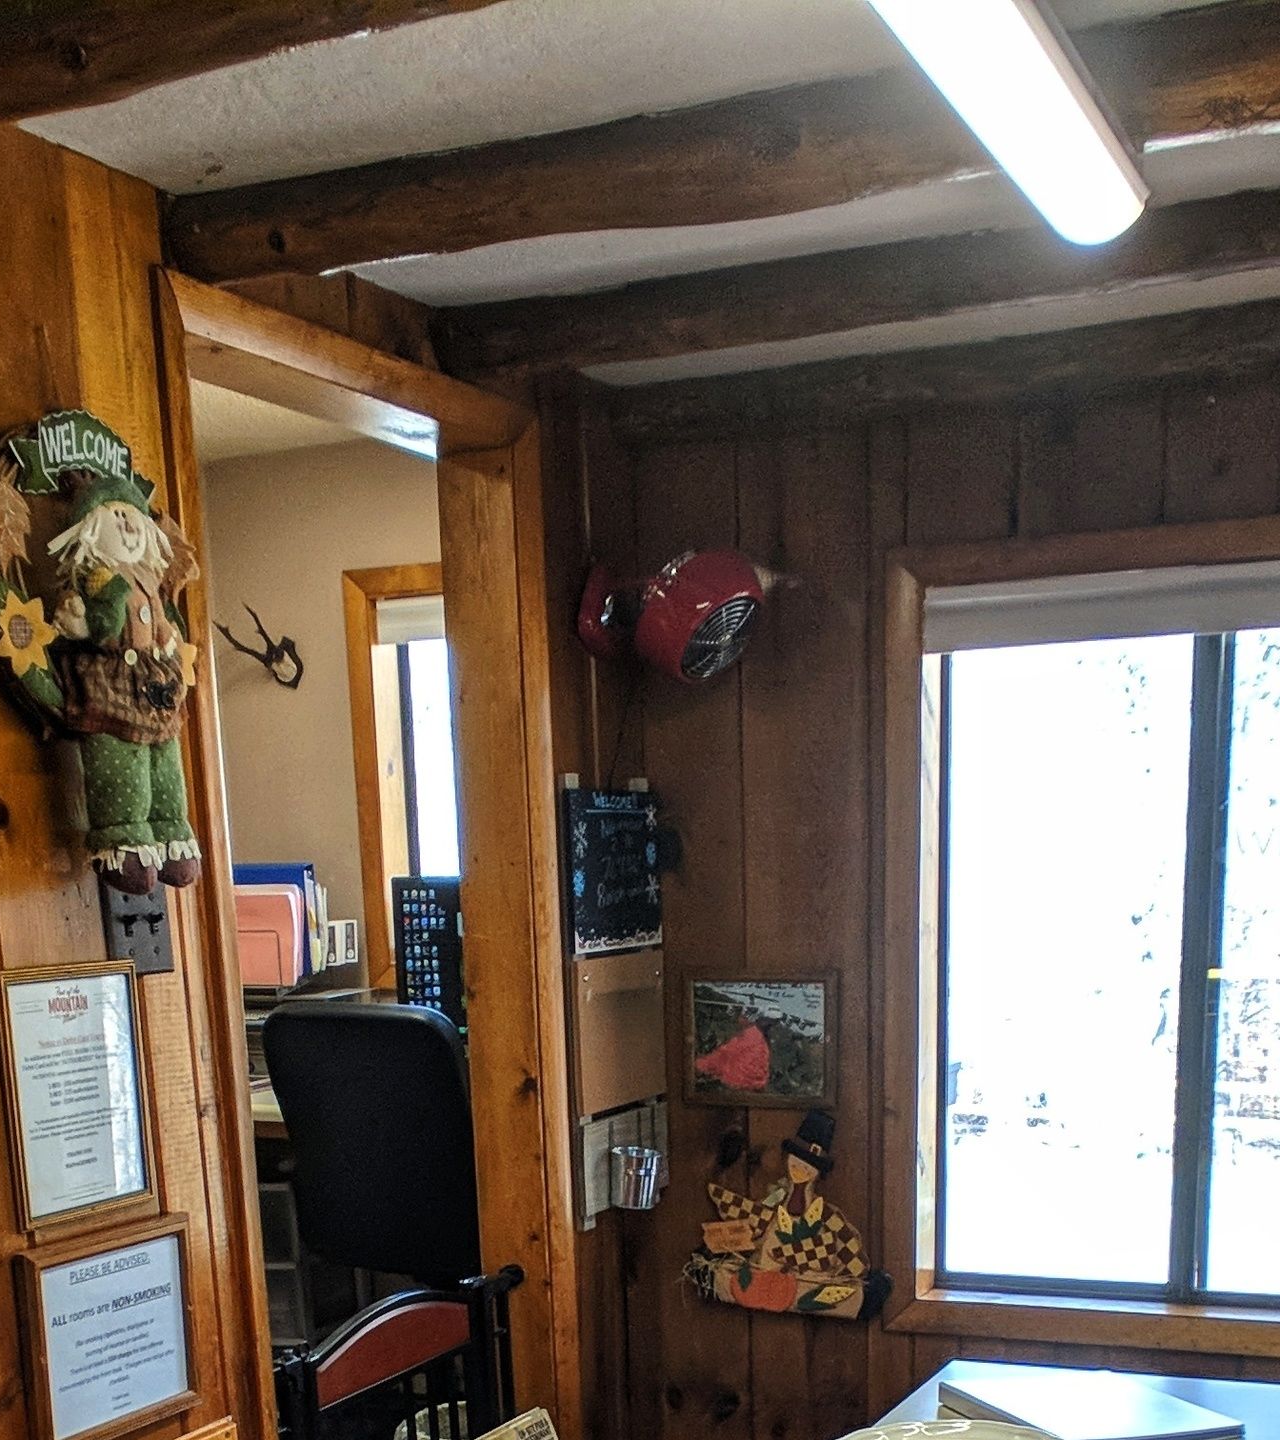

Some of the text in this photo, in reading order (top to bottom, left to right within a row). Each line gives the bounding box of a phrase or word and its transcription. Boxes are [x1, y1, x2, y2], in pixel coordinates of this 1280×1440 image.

[41, 420, 129, 476] WELCOME
[69, 1263, 100, 1282] PLEASE
[101, 1260, 112, 1274] BE
[51, 1282, 172, 1328] ALL rooms are NON-SMOKING
